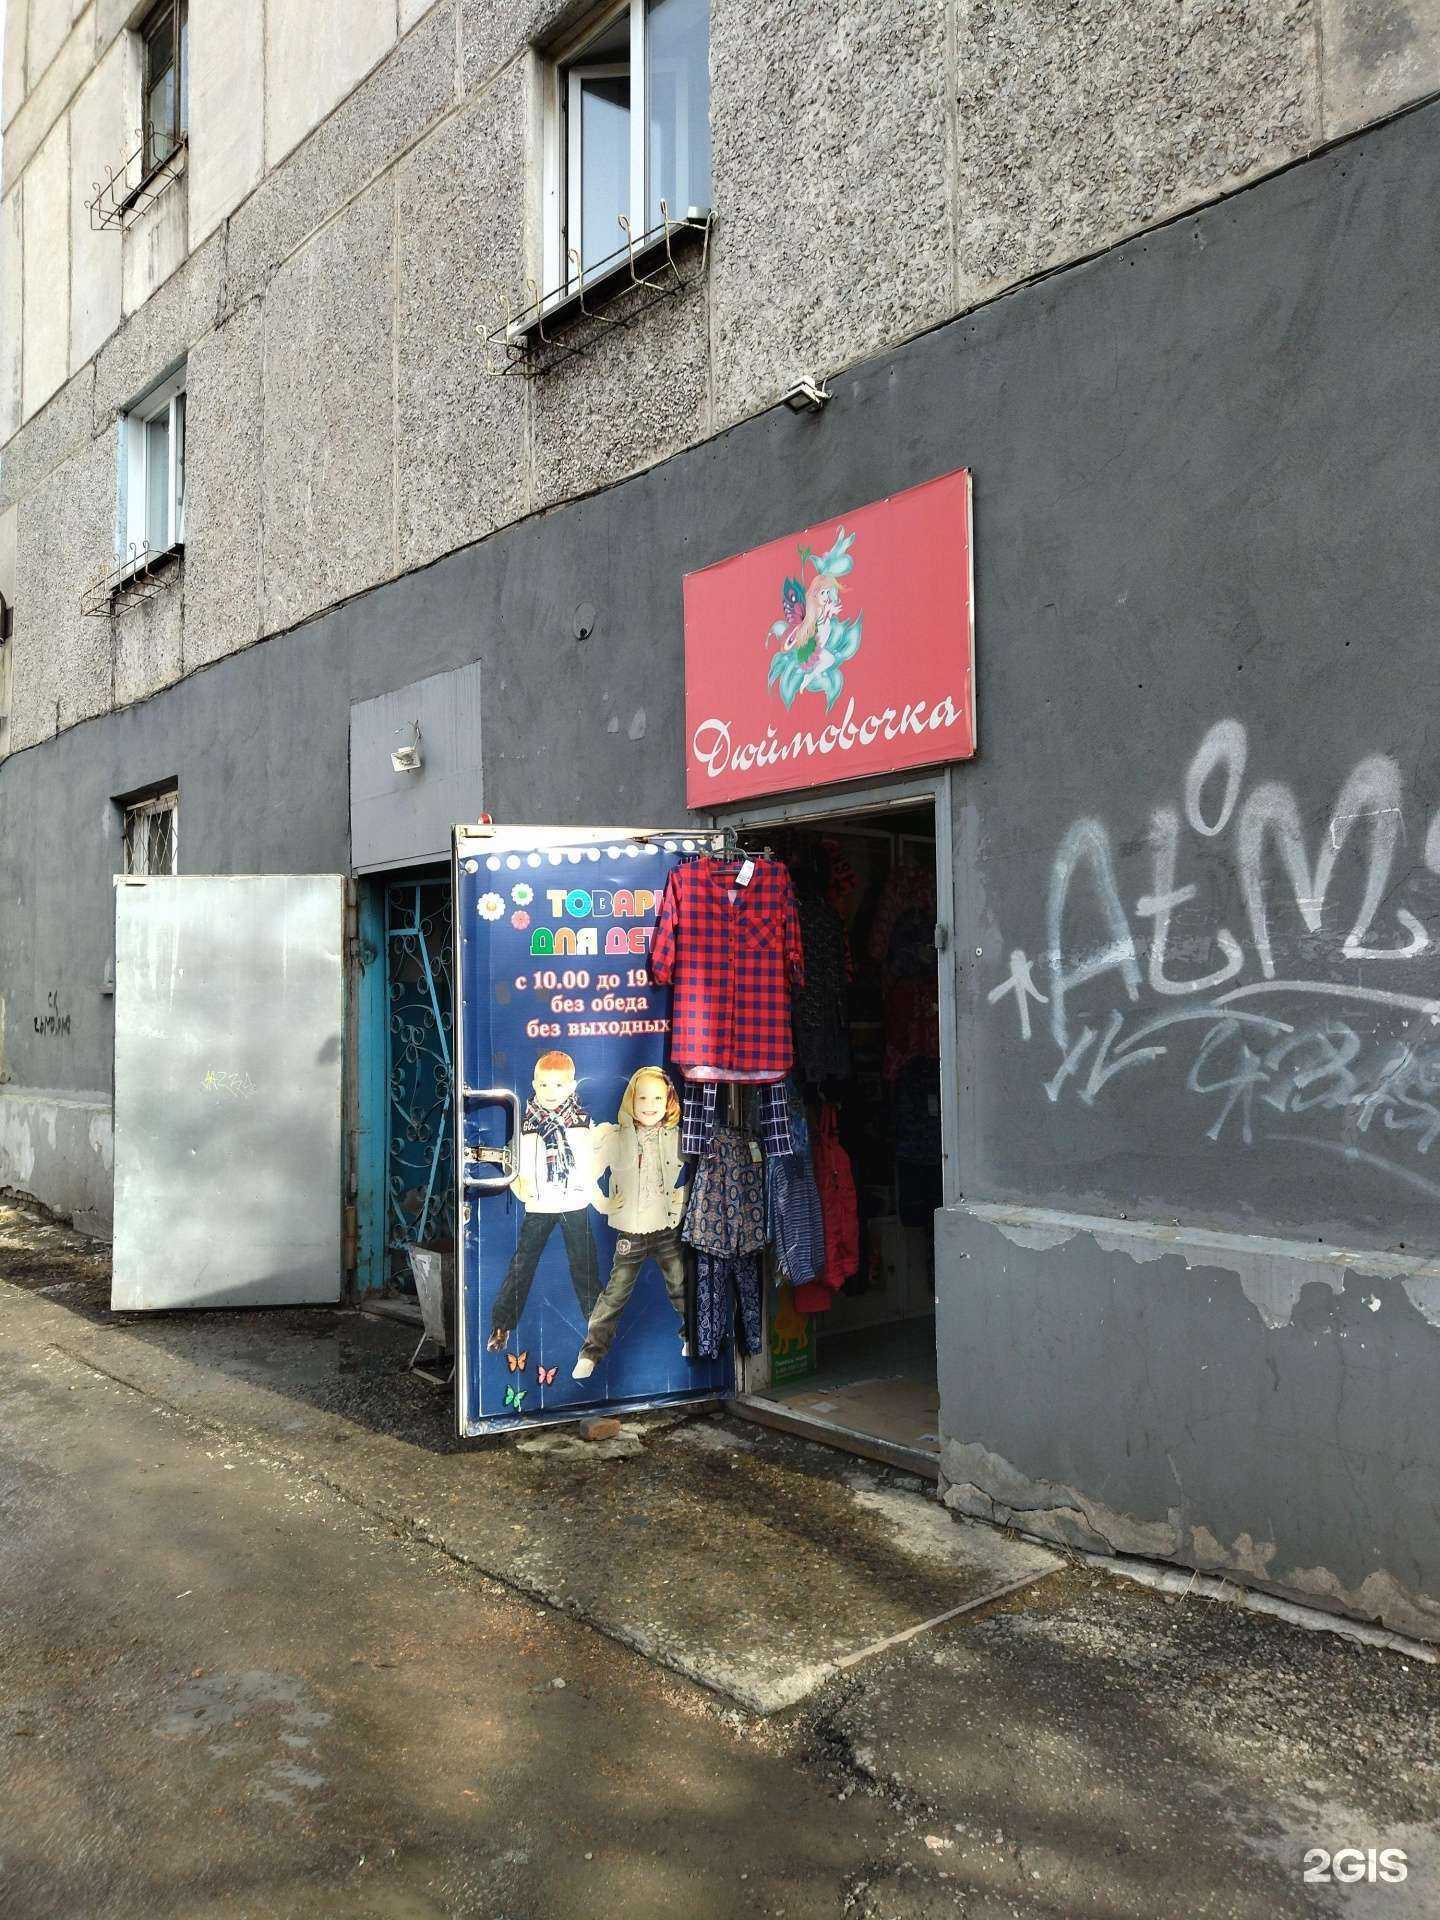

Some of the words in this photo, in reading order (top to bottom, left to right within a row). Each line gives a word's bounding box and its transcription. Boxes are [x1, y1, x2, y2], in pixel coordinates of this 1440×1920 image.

[693, 696, 963, 777] Дюймовочка
[530, 927, 598, 955] ДЛЯ
[605, 926, 659, 955] ДЕТ
[515, 975, 527, 990] с
[532, 970, 589, 989] 10.00
[596, 974, 621, 992] до
[625, 968, 653, 988] 19.
[551, 995, 589, 1013] без
[591, 995, 648, 1013] обеда
[526, 1019, 565, 1038] без
[567, 1018, 671, 1039] выходных
